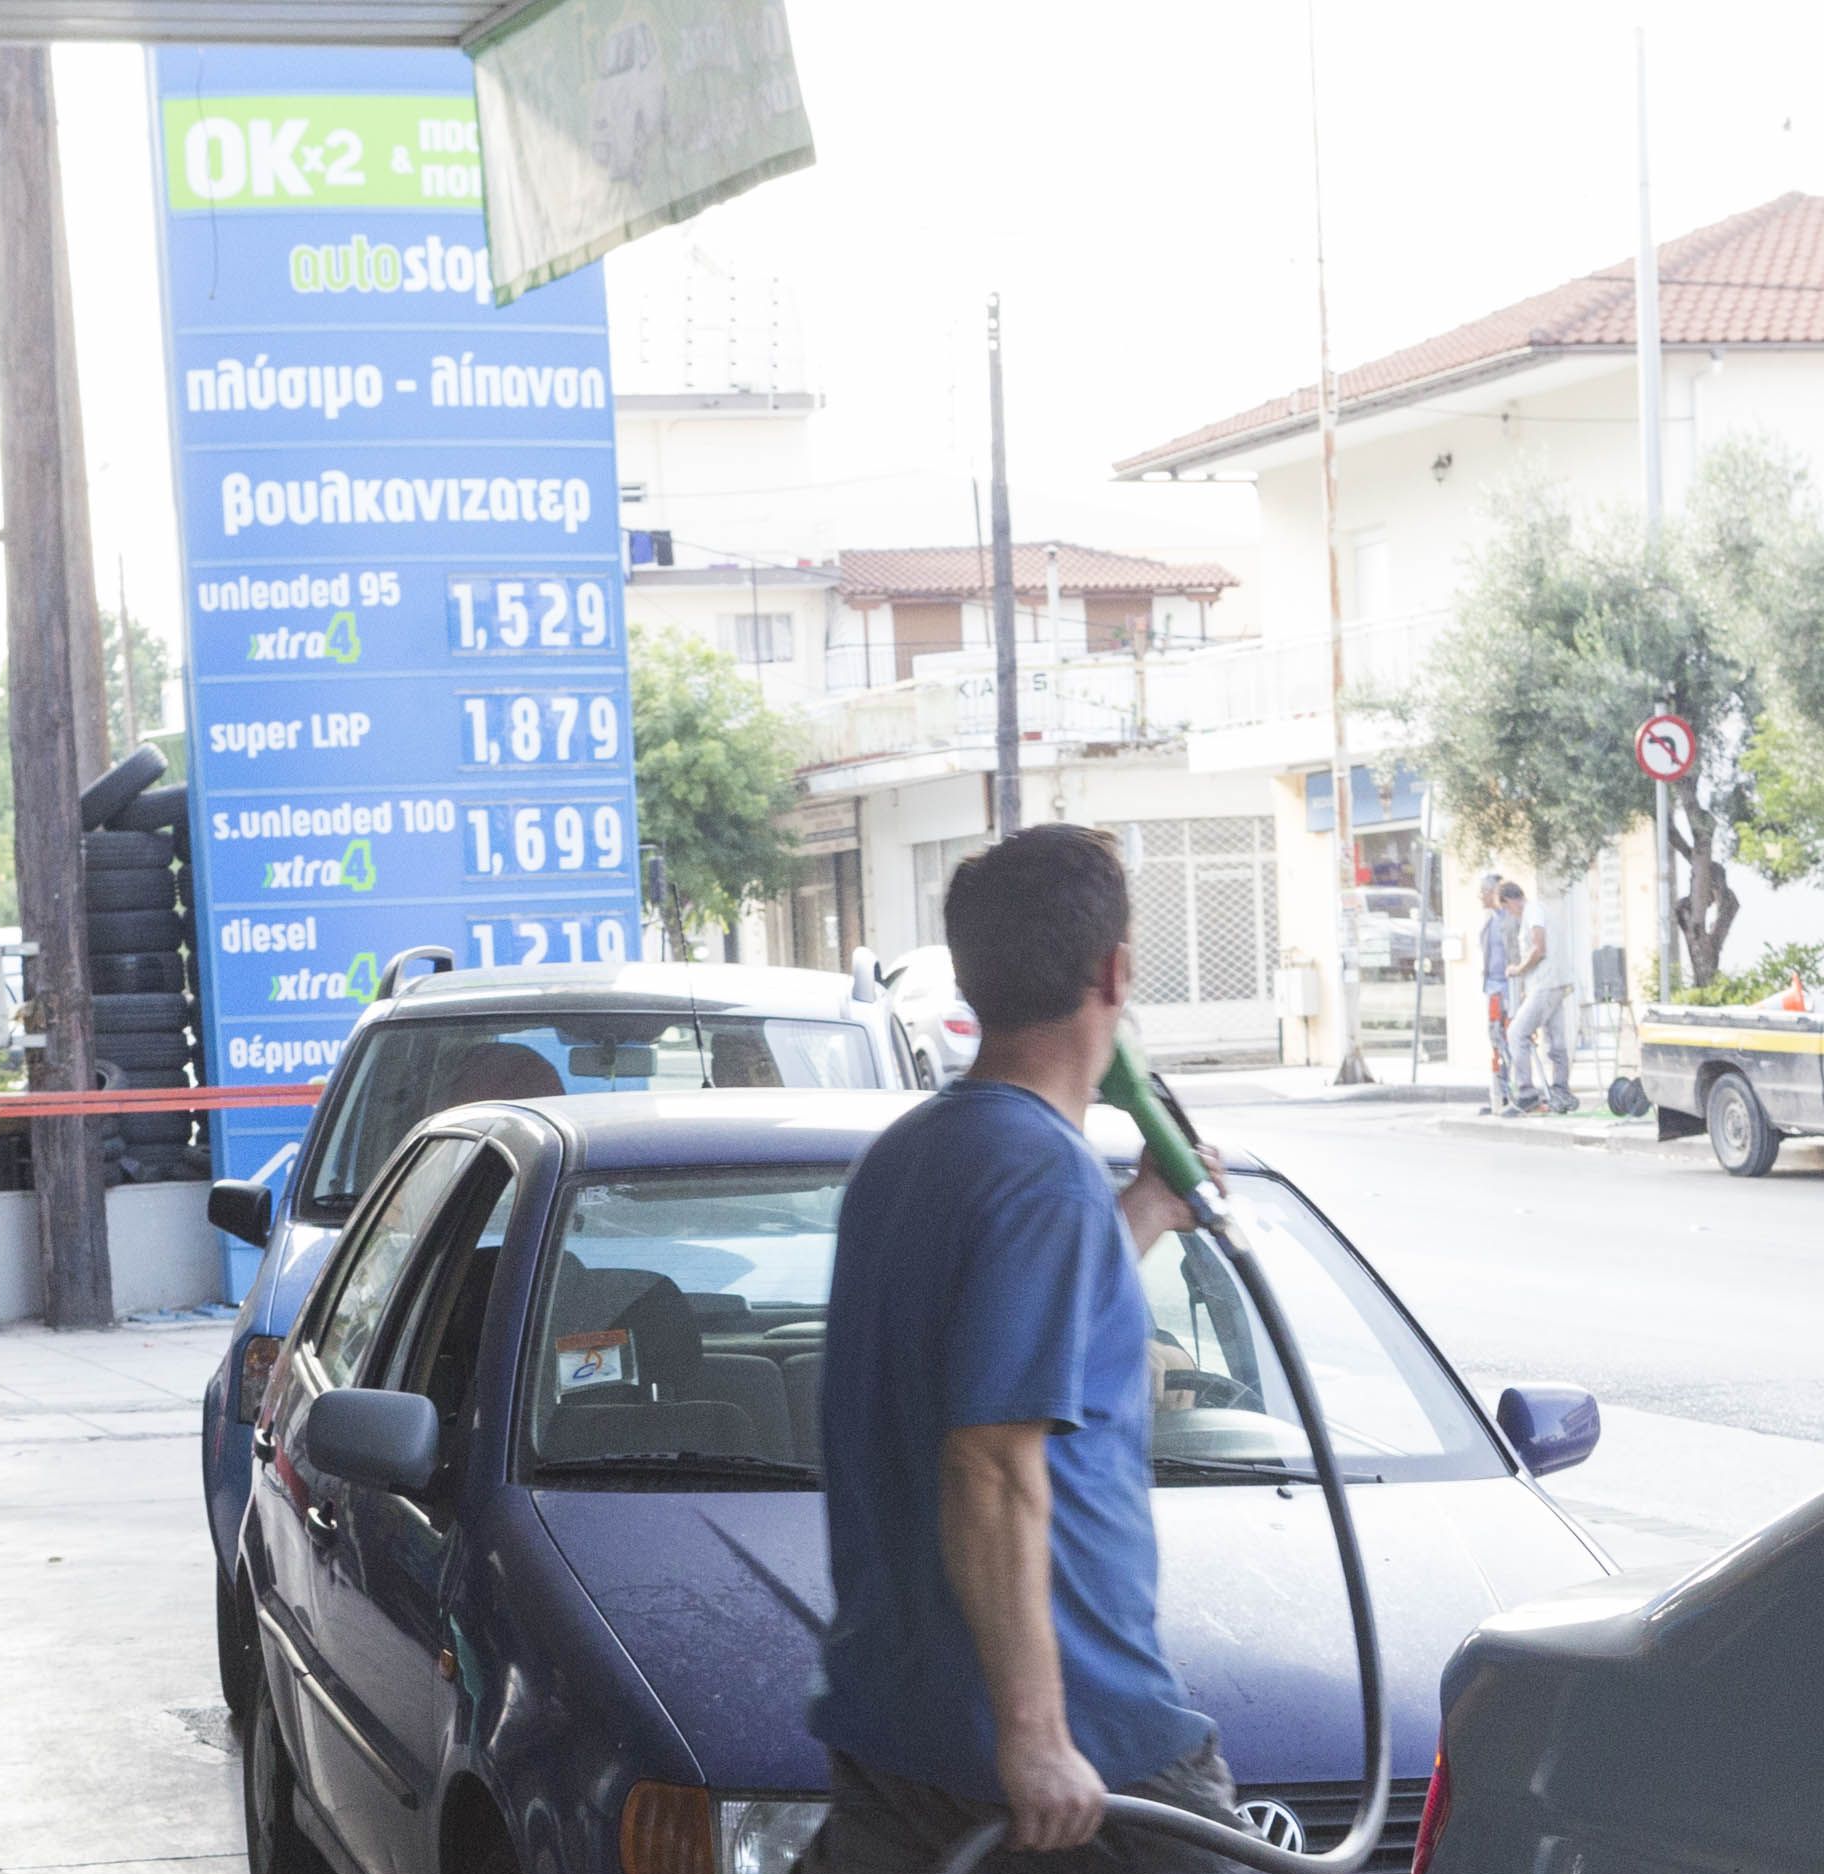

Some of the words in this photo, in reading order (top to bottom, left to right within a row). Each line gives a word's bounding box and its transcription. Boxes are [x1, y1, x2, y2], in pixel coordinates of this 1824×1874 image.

[389, 145, 415, 174] &
[185, 353, 384, 419] πλύσιμο
[430, 351, 607, 410] λίπανση
[221, 469, 591, 536] βουλκανιζατερ
[197, 572, 351, 612] unleaded
[359, 570, 401, 607] 95
[454, 581, 608, 653] 1,529
[209, 718, 302, 758] super
[311, 712, 371, 750] LRP
[465, 696, 619, 765] 1,879
[212, 802, 393, 841] s.unleaded
[398, 799, 455, 834] 100
[467, 805, 623, 877] 1,699
[221, 917, 317, 954] diesel
